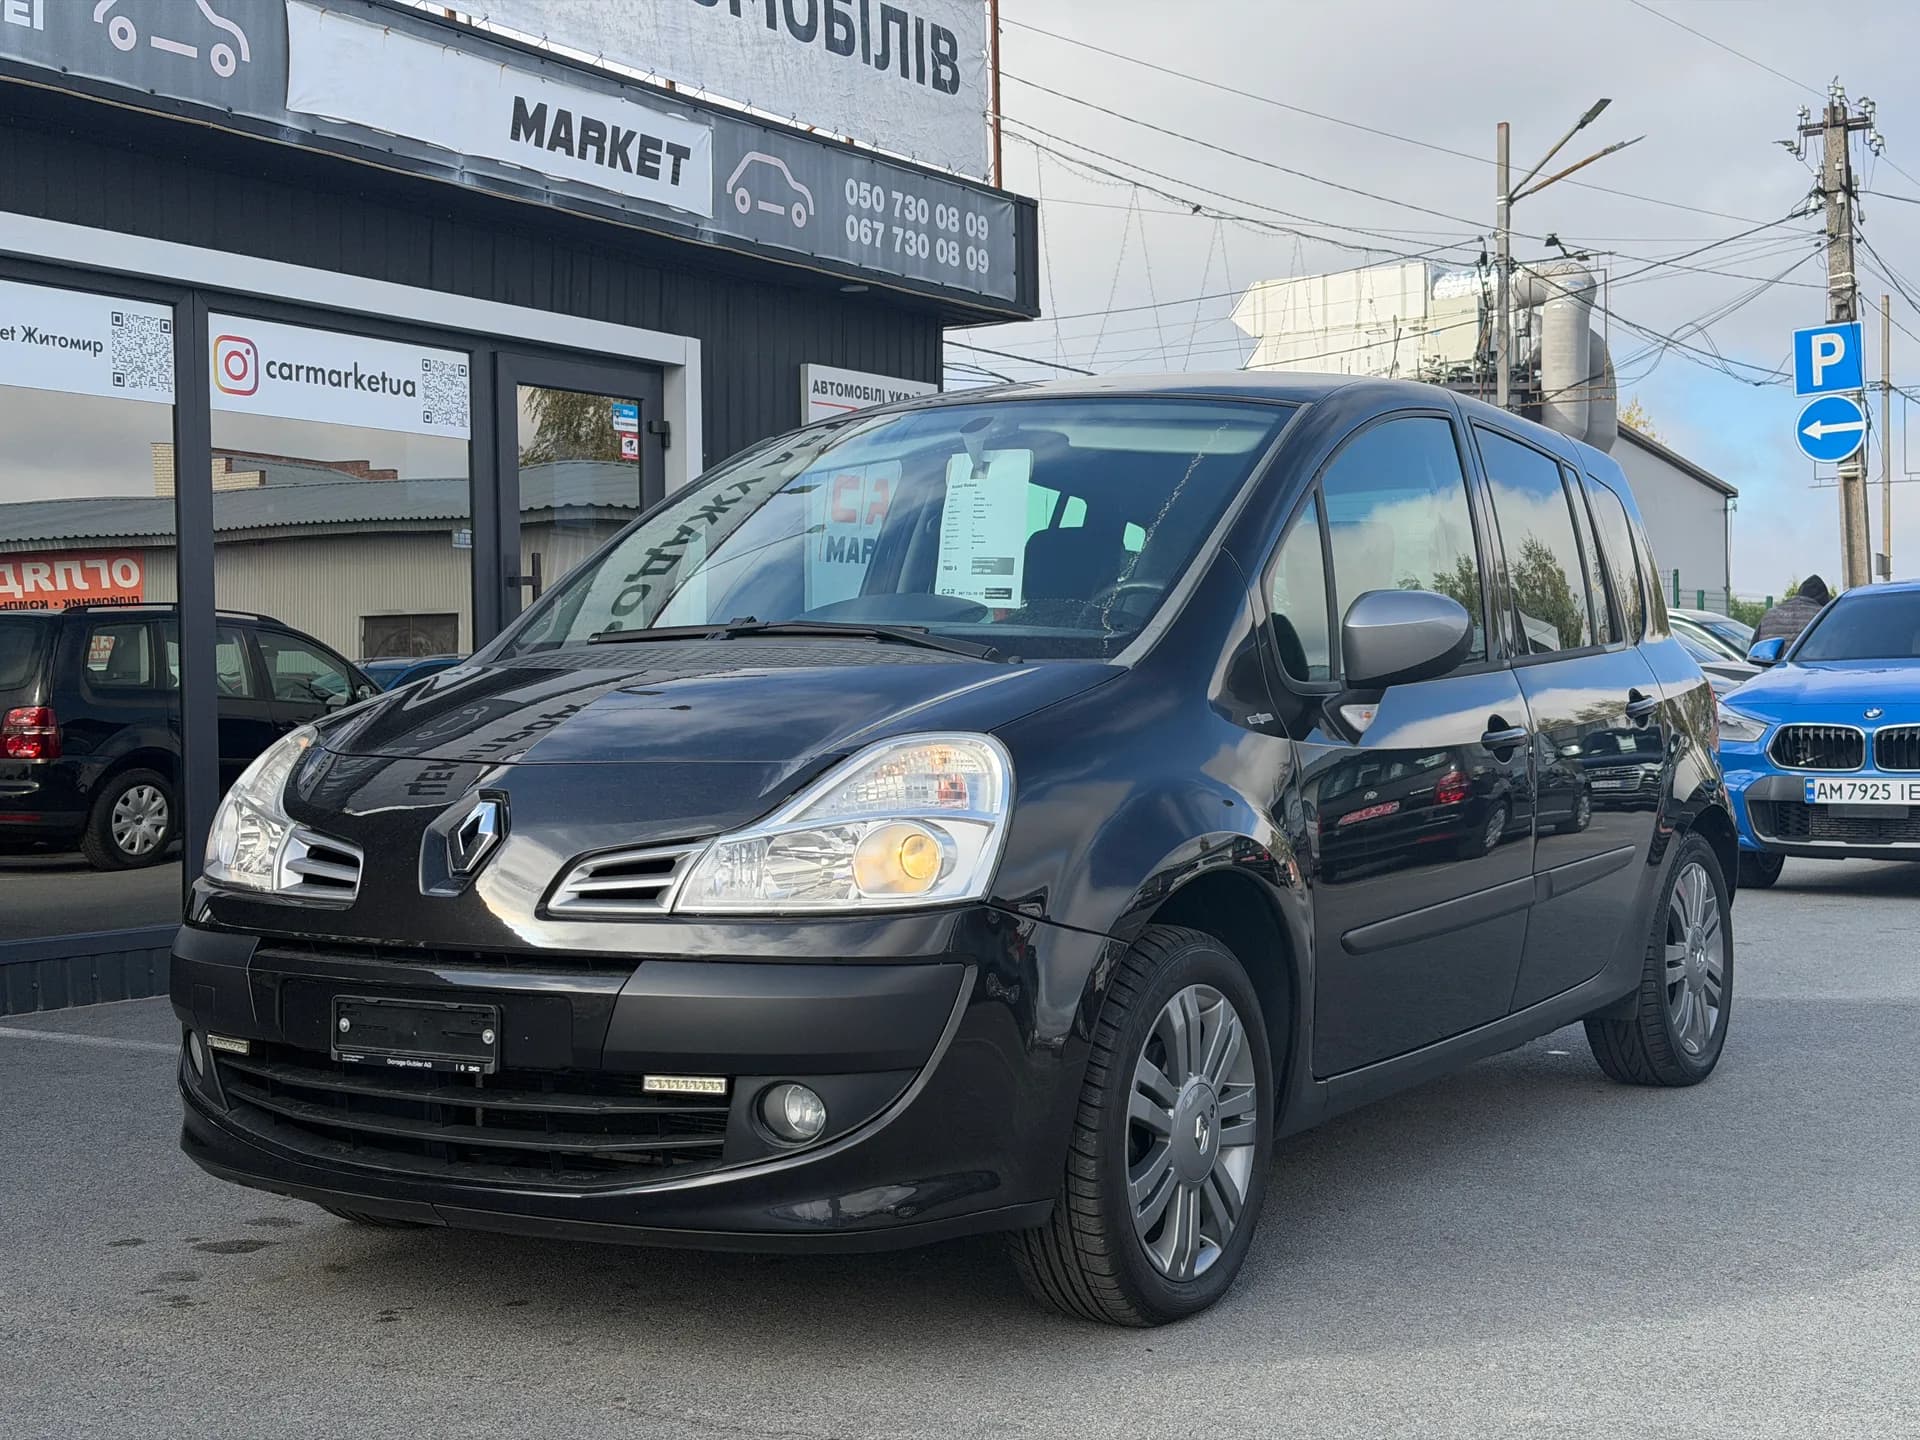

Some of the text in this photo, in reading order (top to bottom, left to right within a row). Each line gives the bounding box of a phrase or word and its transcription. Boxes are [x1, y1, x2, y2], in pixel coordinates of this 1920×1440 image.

[510, 95, 691, 186] MARKET
[845, 178, 989, 241] 050 730 08 09
[845, 214, 989, 274] 067 730 08 09
[20, 325, 104, 357] Житомир
[1811, 332, 1845, 387] P
[266, 360, 416, 398] carmarketua
[812, 379, 885, 405] АВТОМОБІЛІ
[1817, 783, 1843, 800] AM
[1847, 783, 1891, 800] 7925
